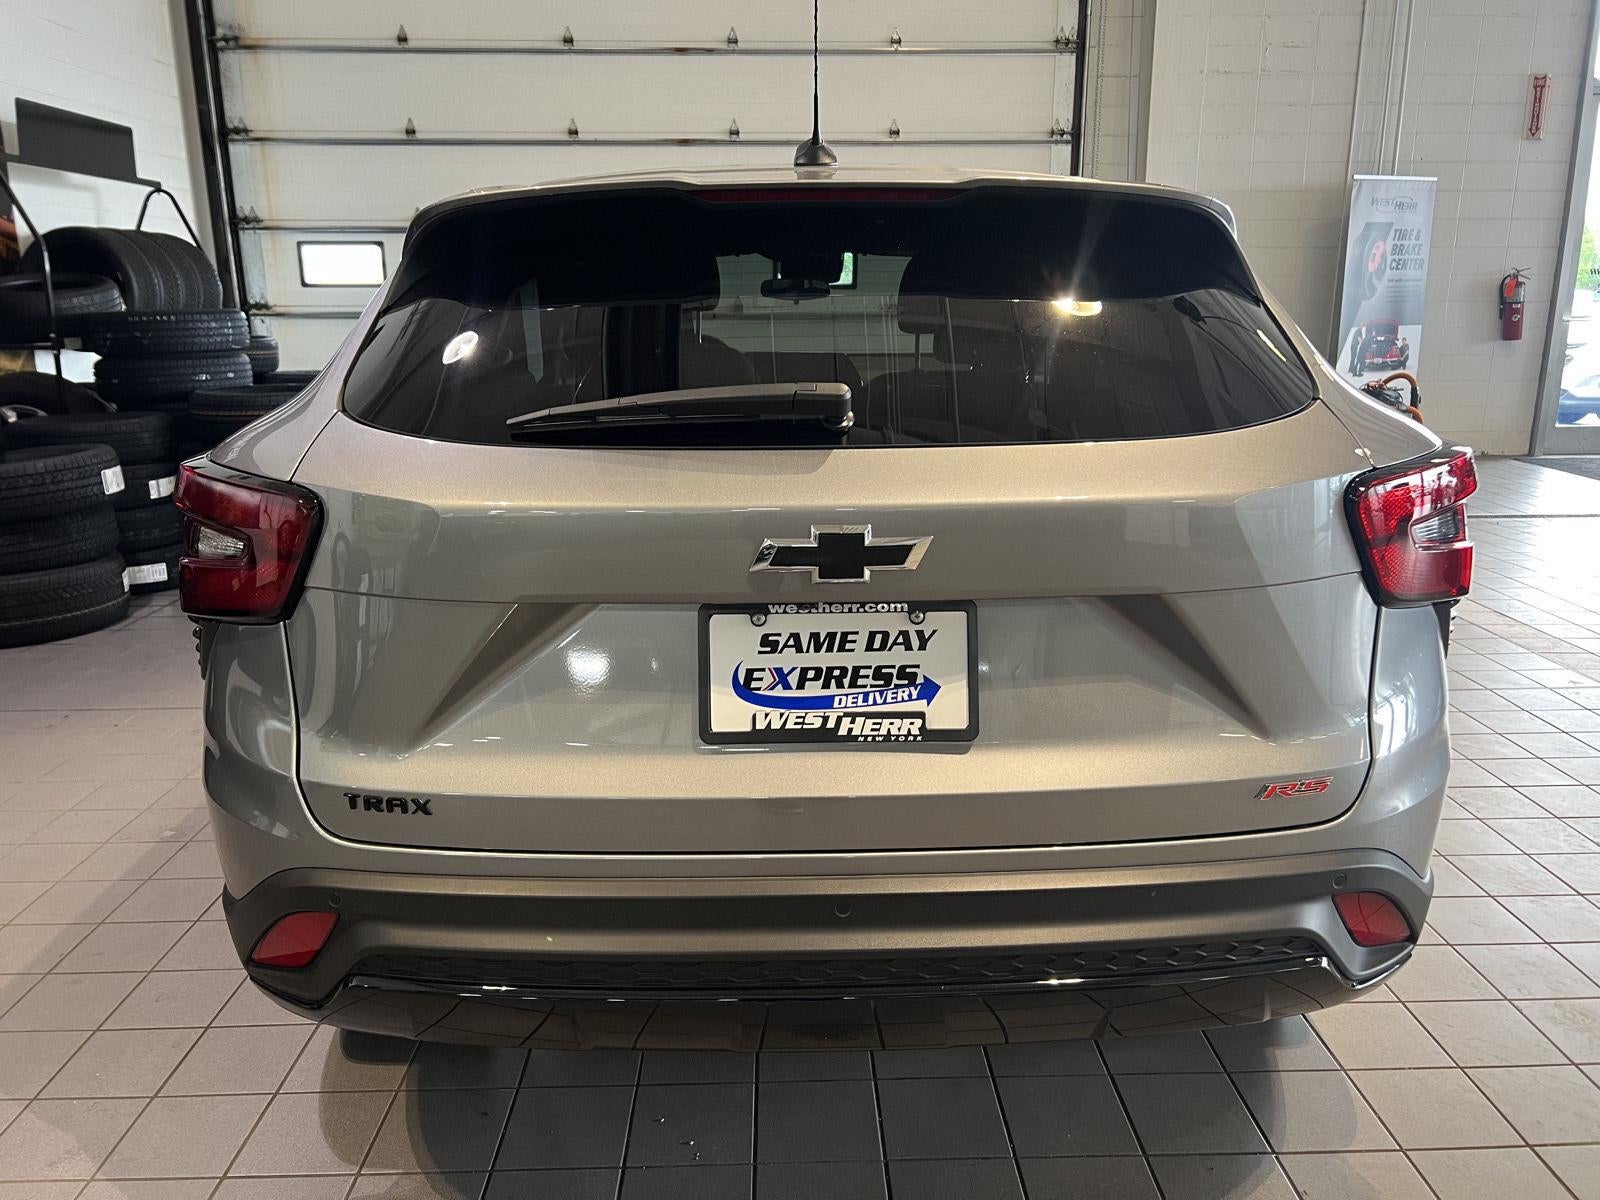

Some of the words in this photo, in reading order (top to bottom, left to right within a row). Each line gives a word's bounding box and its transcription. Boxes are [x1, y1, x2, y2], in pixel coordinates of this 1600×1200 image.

[1392, 228, 1414, 241] TIRE
[1414, 228, 1422, 241] &
[1391, 243, 1424, 257] BRAKE
[1389, 258, 1425, 271] CENTER
[757, 630, 860, 655] SAME
[864, 628, 938, 652] DAY
[742, 663, 922, 692] EXPRESS
[832, 685, 923, 709] DELIVERY
[1254, 774, 1334, 801] RS
[343, 792, 433, 815] TRAX
